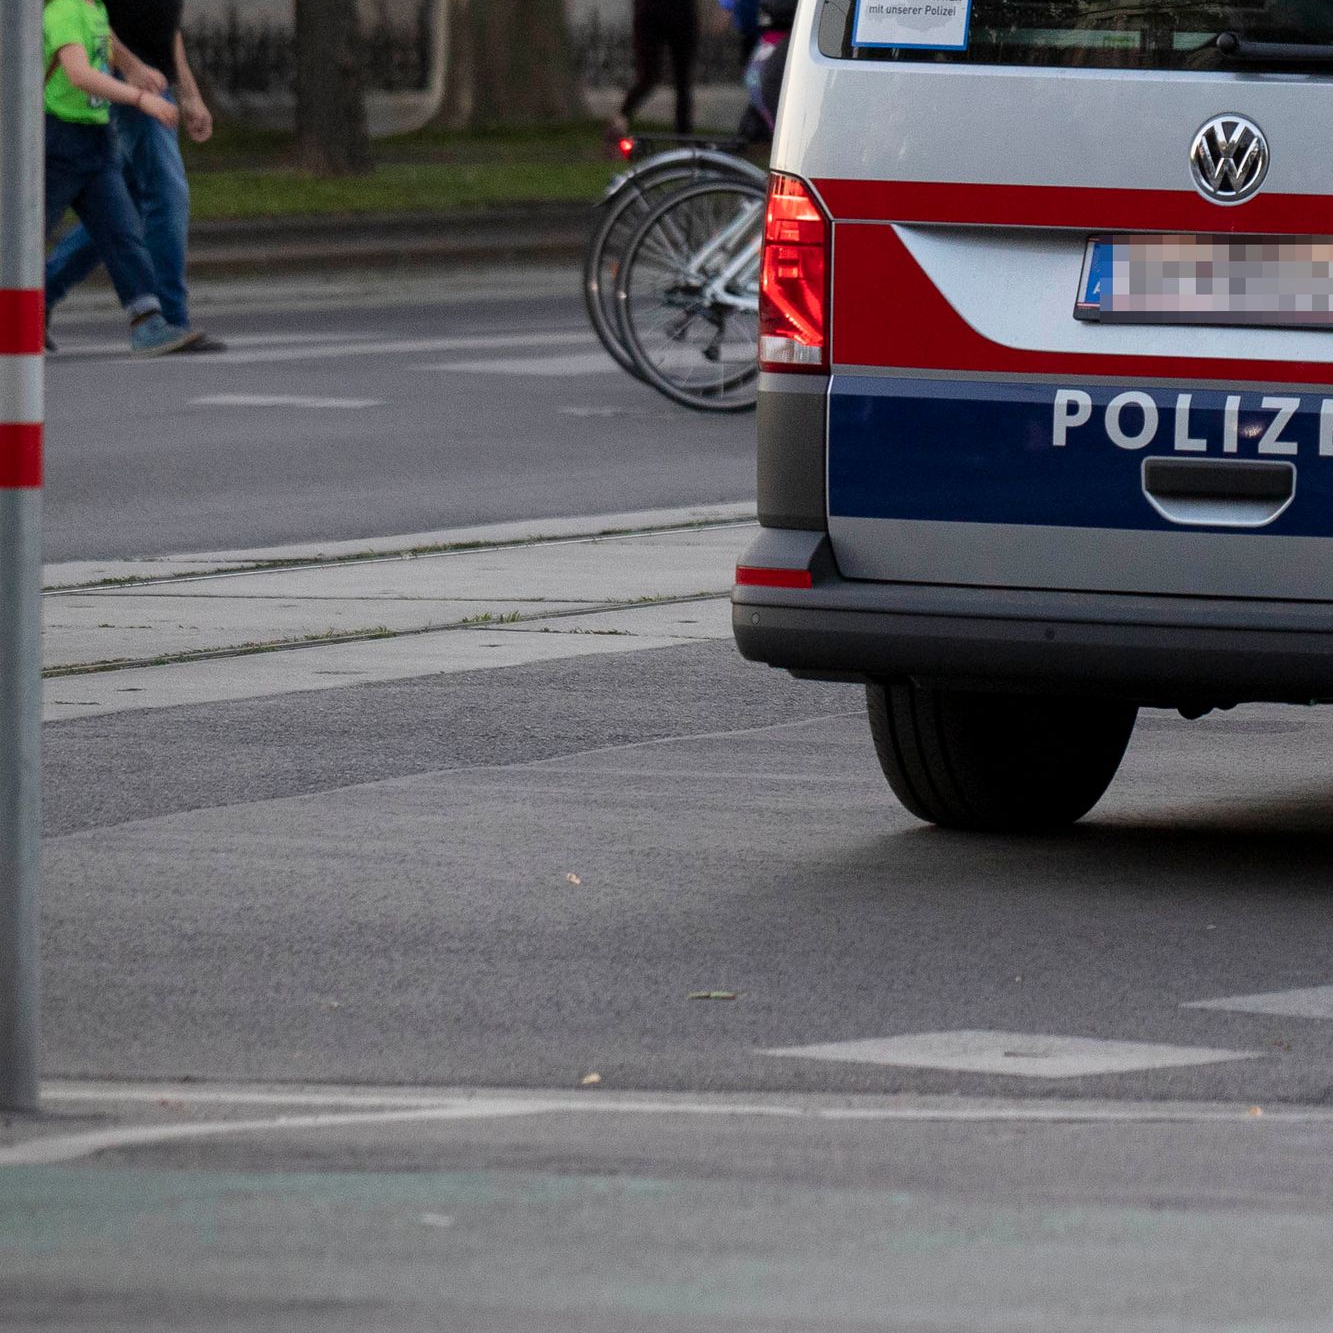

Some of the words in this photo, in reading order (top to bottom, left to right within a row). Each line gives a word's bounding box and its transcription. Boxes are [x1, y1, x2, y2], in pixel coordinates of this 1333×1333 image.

[868, 5, 884, 15] mit
[886, 5, 921, 16] unserer
[924, 4, 957, 17] Polizei
